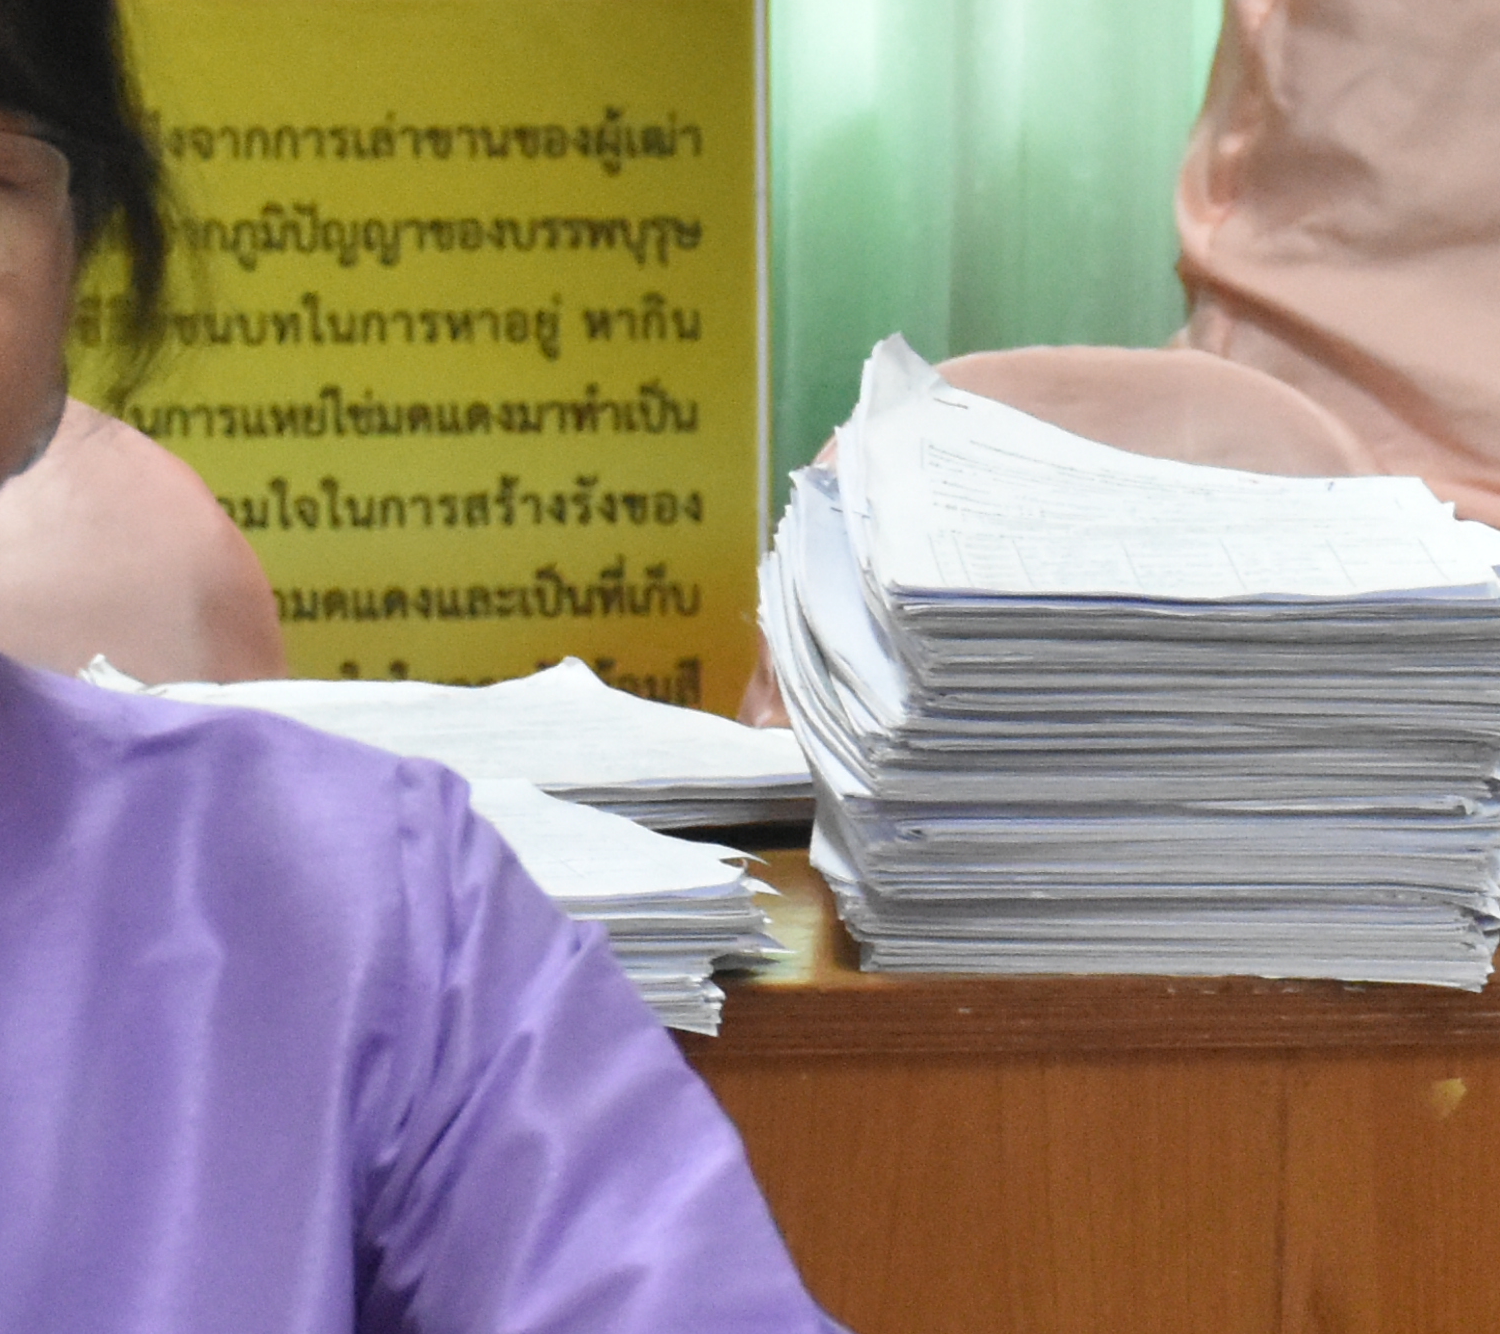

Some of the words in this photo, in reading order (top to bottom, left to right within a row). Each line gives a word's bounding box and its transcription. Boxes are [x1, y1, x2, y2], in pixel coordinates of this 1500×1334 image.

[150, 107, 702, 175] งจากการเล่าขานของผู้เฒ่า
[582, 291, 701, 341] หากิน
